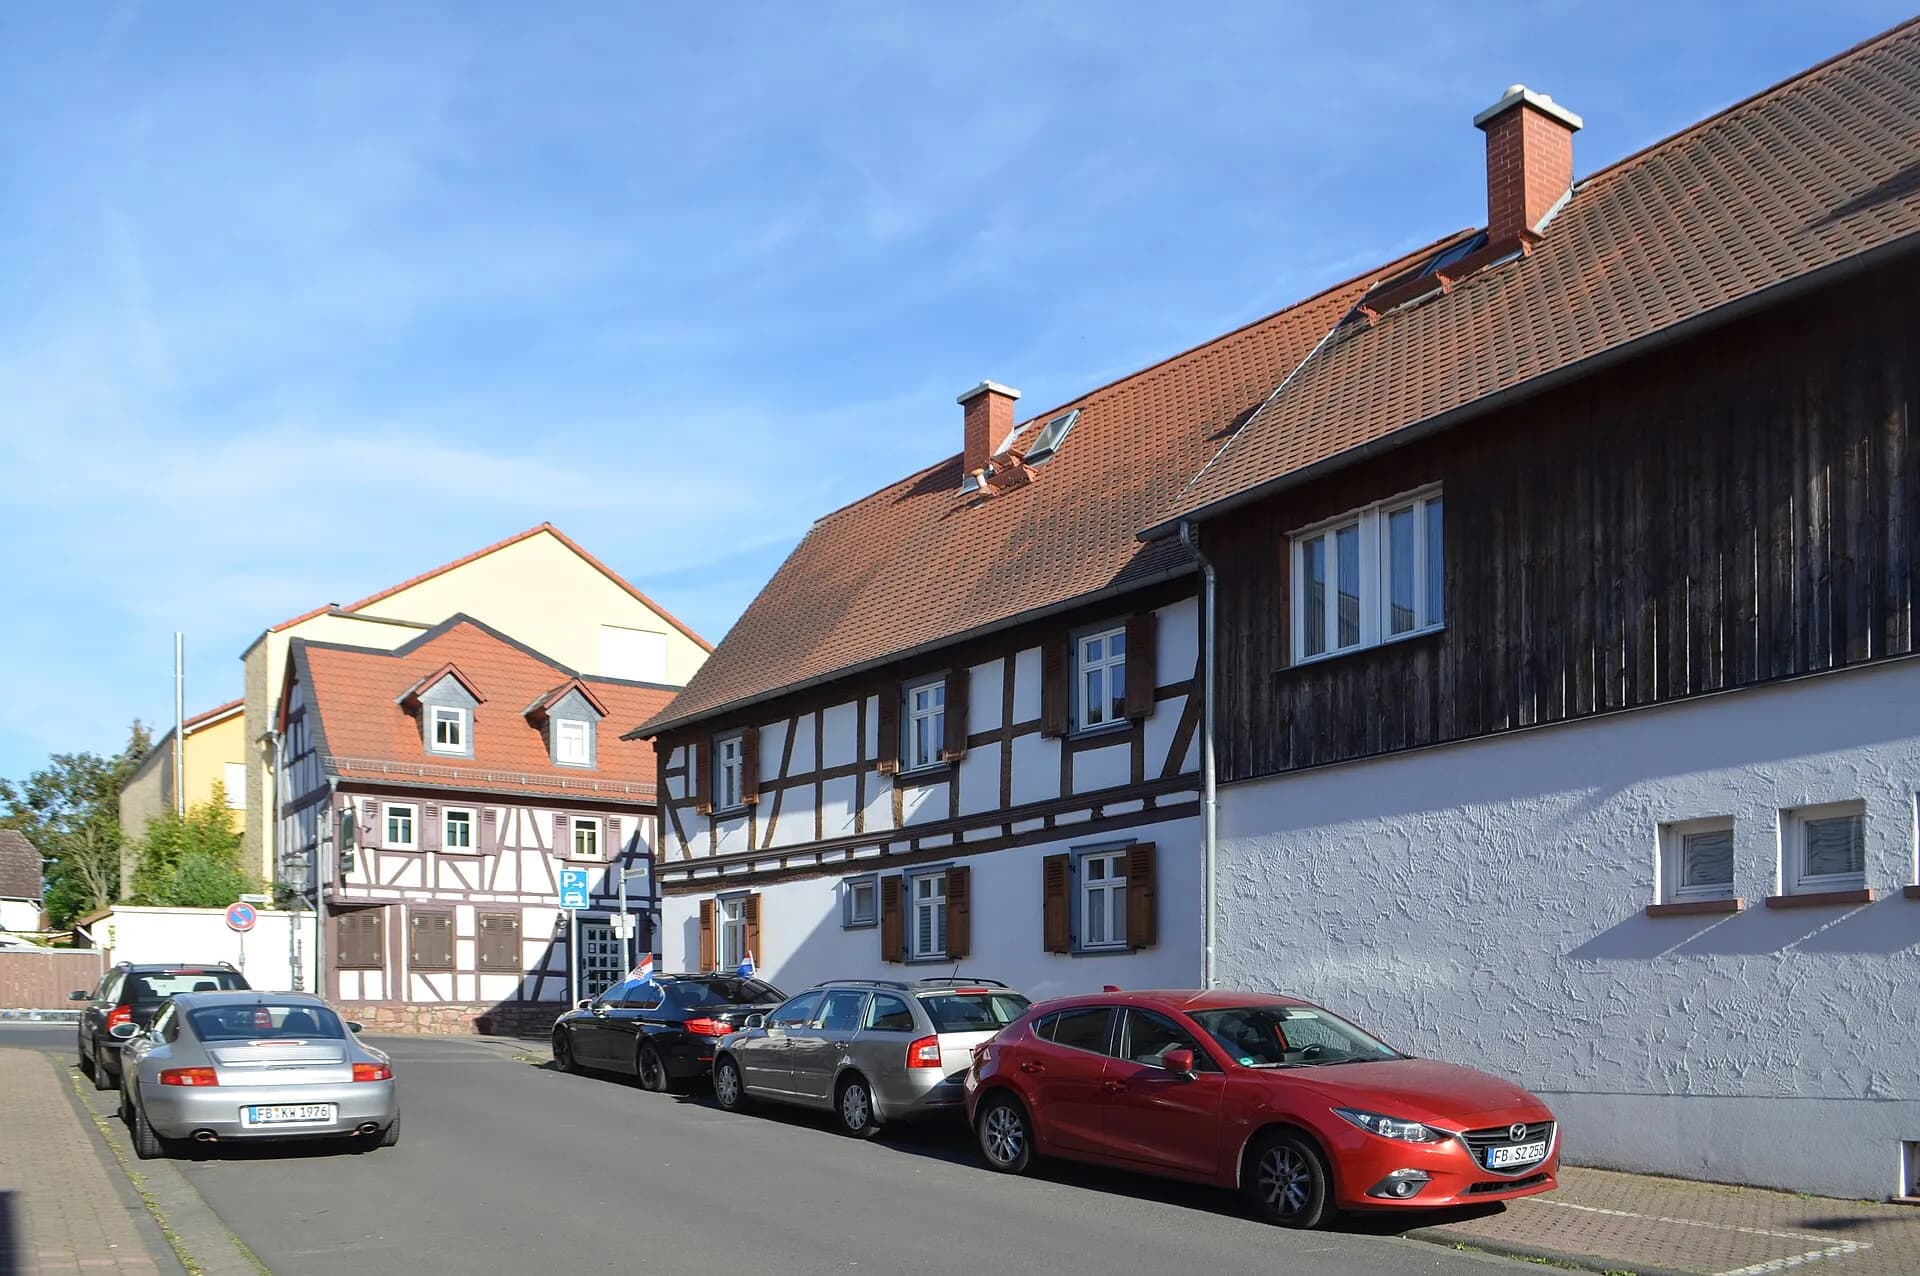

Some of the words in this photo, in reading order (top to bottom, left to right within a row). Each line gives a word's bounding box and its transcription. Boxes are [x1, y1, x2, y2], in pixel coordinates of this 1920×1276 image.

[563, 872, 576, 888] P
[257, 1108, 273, 1119] FB
[281, 1107, 296, 1118] KW
[299, 1106, 328, 1118] 1976
[1494, 1149, 1509, 1163] FB
[1514, 1147, 1528, 1160] SZ
[1528, 1143, 1544, 1158] 258
